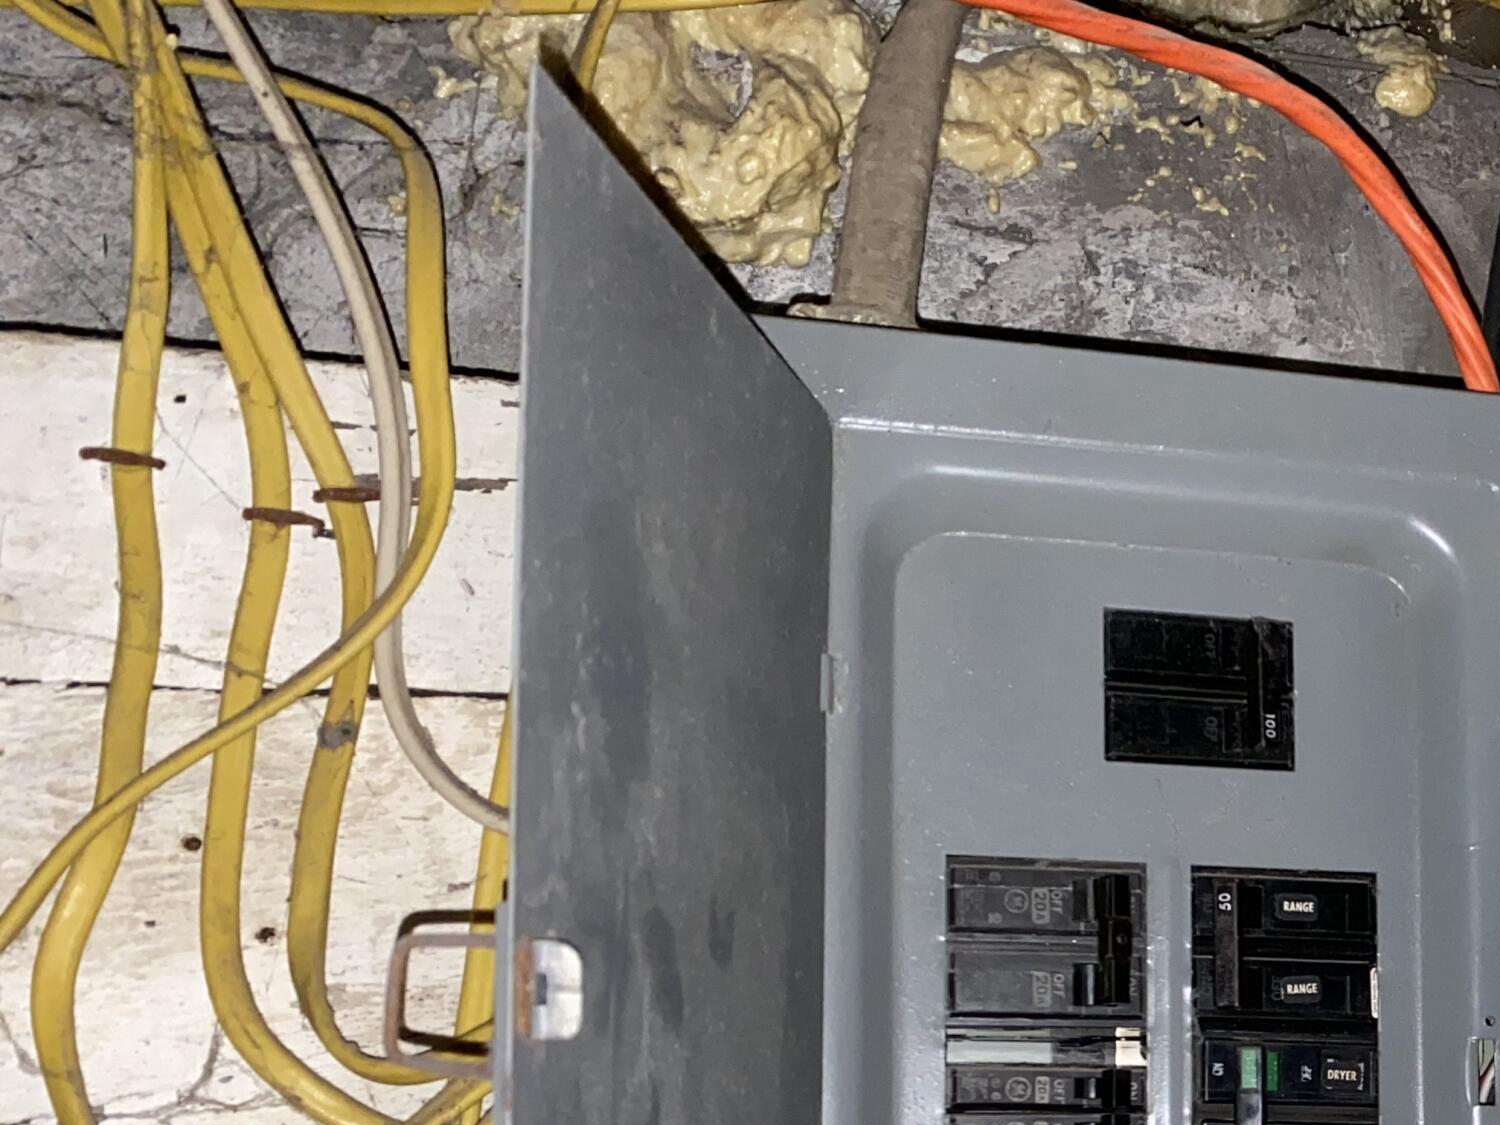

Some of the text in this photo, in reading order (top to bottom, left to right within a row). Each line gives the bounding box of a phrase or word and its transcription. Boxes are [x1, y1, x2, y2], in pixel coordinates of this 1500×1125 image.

[1264, 713, 1278, 739] 100
[1034, 891, 1047, 921] 20A
[1051, 889, 1064, 916] OFF
[1218, 892, 1233, 912] 50
[1282, 900, 1315, 913] RANGE
[1036, 975, 1047, 1005] 20A
[1054, 973, 1065, 998] OFF
[1286, 982, 1319, 995] RANGE
[1212, 1062, 1225, 1077] ON
[1326, 1069, 1357, 1082] DRYER
[1036, 1079, 1047, 1102] 20A
